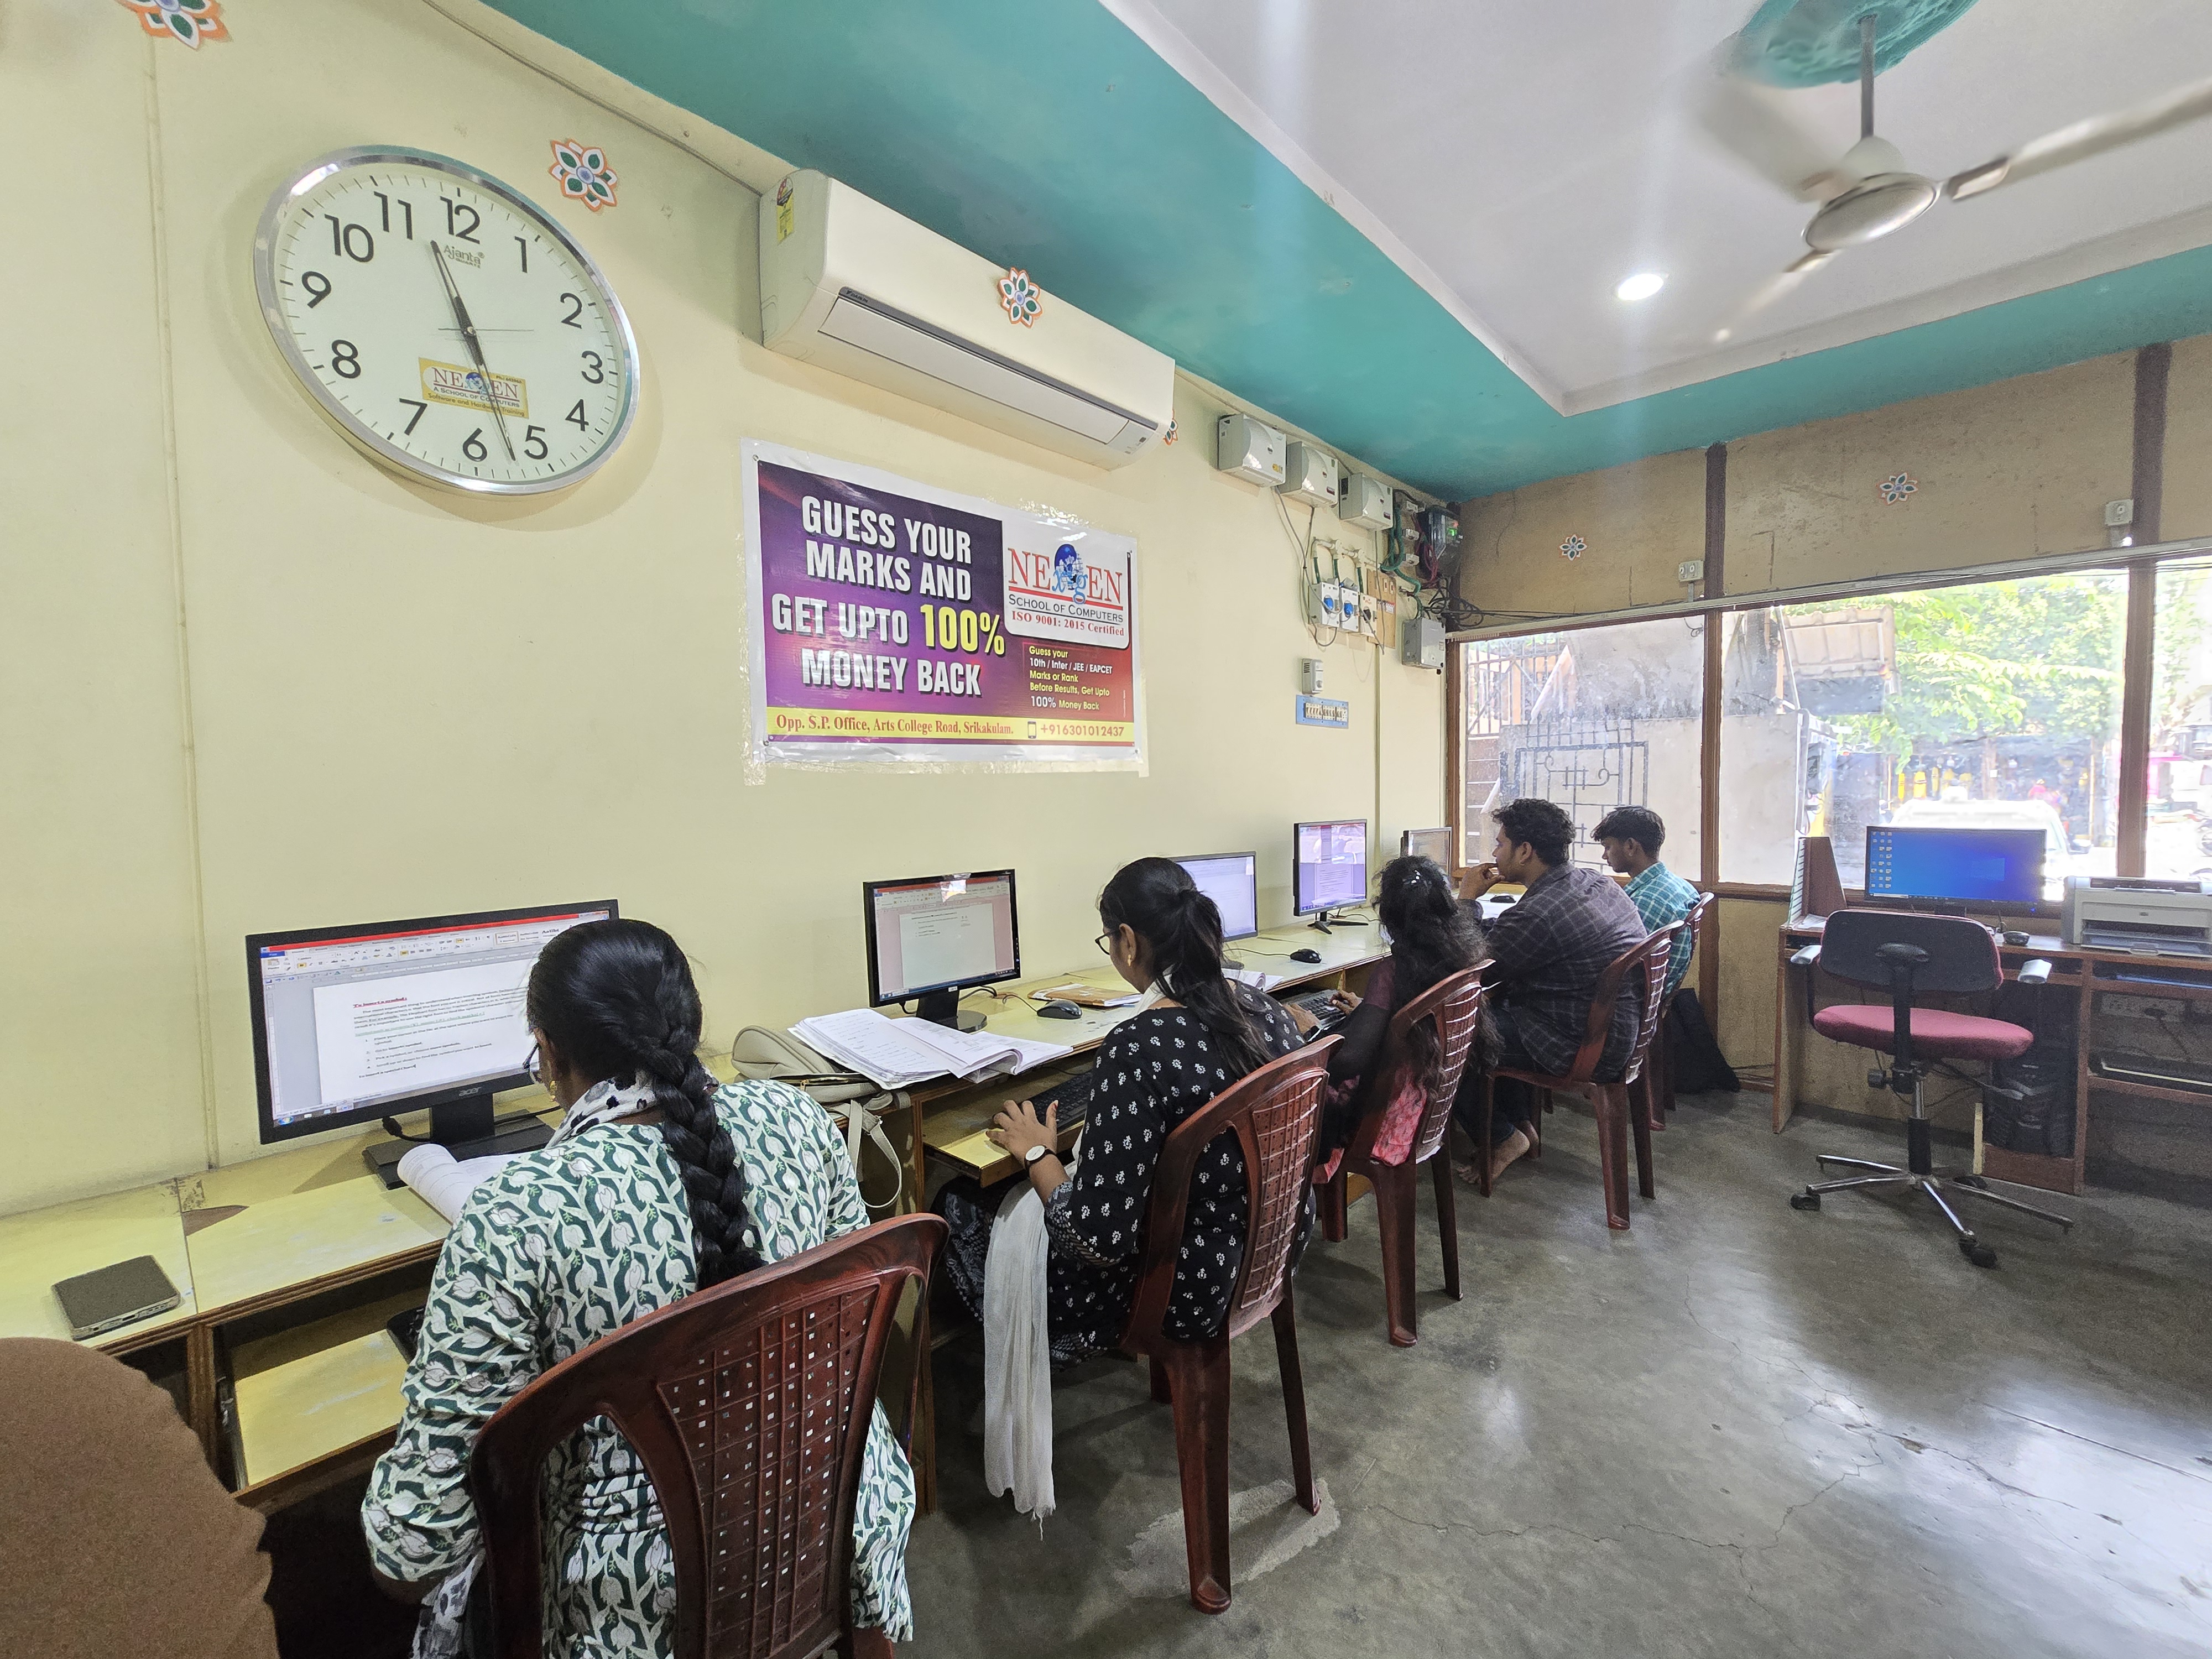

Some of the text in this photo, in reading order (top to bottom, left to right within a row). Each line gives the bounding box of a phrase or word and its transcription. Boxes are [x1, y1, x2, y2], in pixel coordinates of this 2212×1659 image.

[374, 191, 413, 240] 11
[440, 196, 481, 244] 12
[324, 213, 374, 263] 10
[514, 236, 528, 273] 1
[444, 245, 481, 265] Ajanta
[301, 271, 331, 308] 9
[560, 293, 582, 328] 2
[331, 339, 361, 379] 8
[581, 351, 604, 384] 3
[427, 393, 456, 403] Software
[502, 407, 525, 417] Training
[440, 388, 468, 398] SCHOOL
[398, 398, 427, 435] 7
[565, 399, 589, 431] 4
[463, 427, 488, 462] 6
[524, 425, 548, 460] 5
[802, 496, 972, 564] GUESS YOUR
[806, 540, 972, 601] MARKS AND
[771, 593, 1005, 655] GET UPTO 100%
[1009, 594, 1124, 623] SCHOOL OF COMPUTERS
[1012, 611, 1124, 636] ISO 9001: 2015 Certified
[1029, 646, 1068, 659] Guess your
[1030, 658, 1046, 667] 10th
[1052, 660, 1068, 670] Inter
[1073, 662, 1084, 672] JEE
[1089, 664, 1113, 674] EAPCET
[801, 648, 982, 696] MONEY BACK
[1030, 670, 1051, 681] Marks
[1062, 674, 1079, 682] Rank
[1030, 682, 1110, 697] Before Results, Get Upto
[1031, 696, 1100, 711] 100% Money Back
[776, 714, 1014, 736] Opp. S.P. Office, Arts College Road, Srikakulam.
[1041, 724, 1125, 737] +916301012437
[459, 1087, 482, 1097] acer
